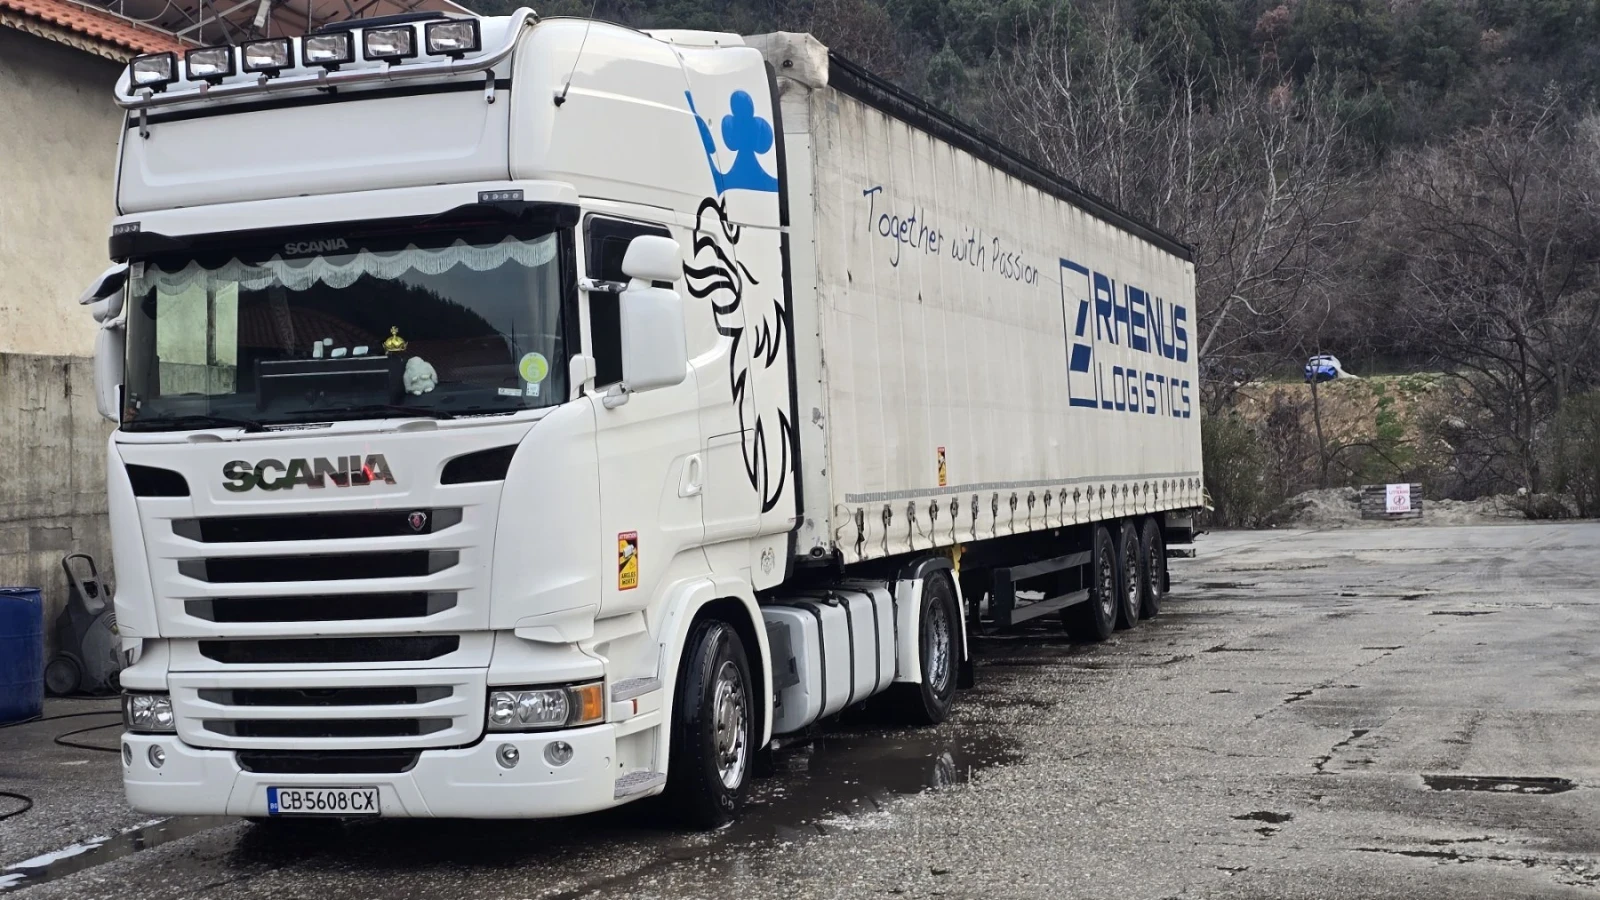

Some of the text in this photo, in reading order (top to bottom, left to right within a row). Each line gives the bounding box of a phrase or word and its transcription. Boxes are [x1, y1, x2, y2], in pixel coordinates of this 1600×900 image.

[284, 238, 349, 255] SCANIA
[863, 186, 1039, 287] Together with Passion
[1093, 271, 1188, 363] RHENUS
[1099, 362, 1191, 419] LOGISTICS
[222, 453, 397, 493] SCANIA
